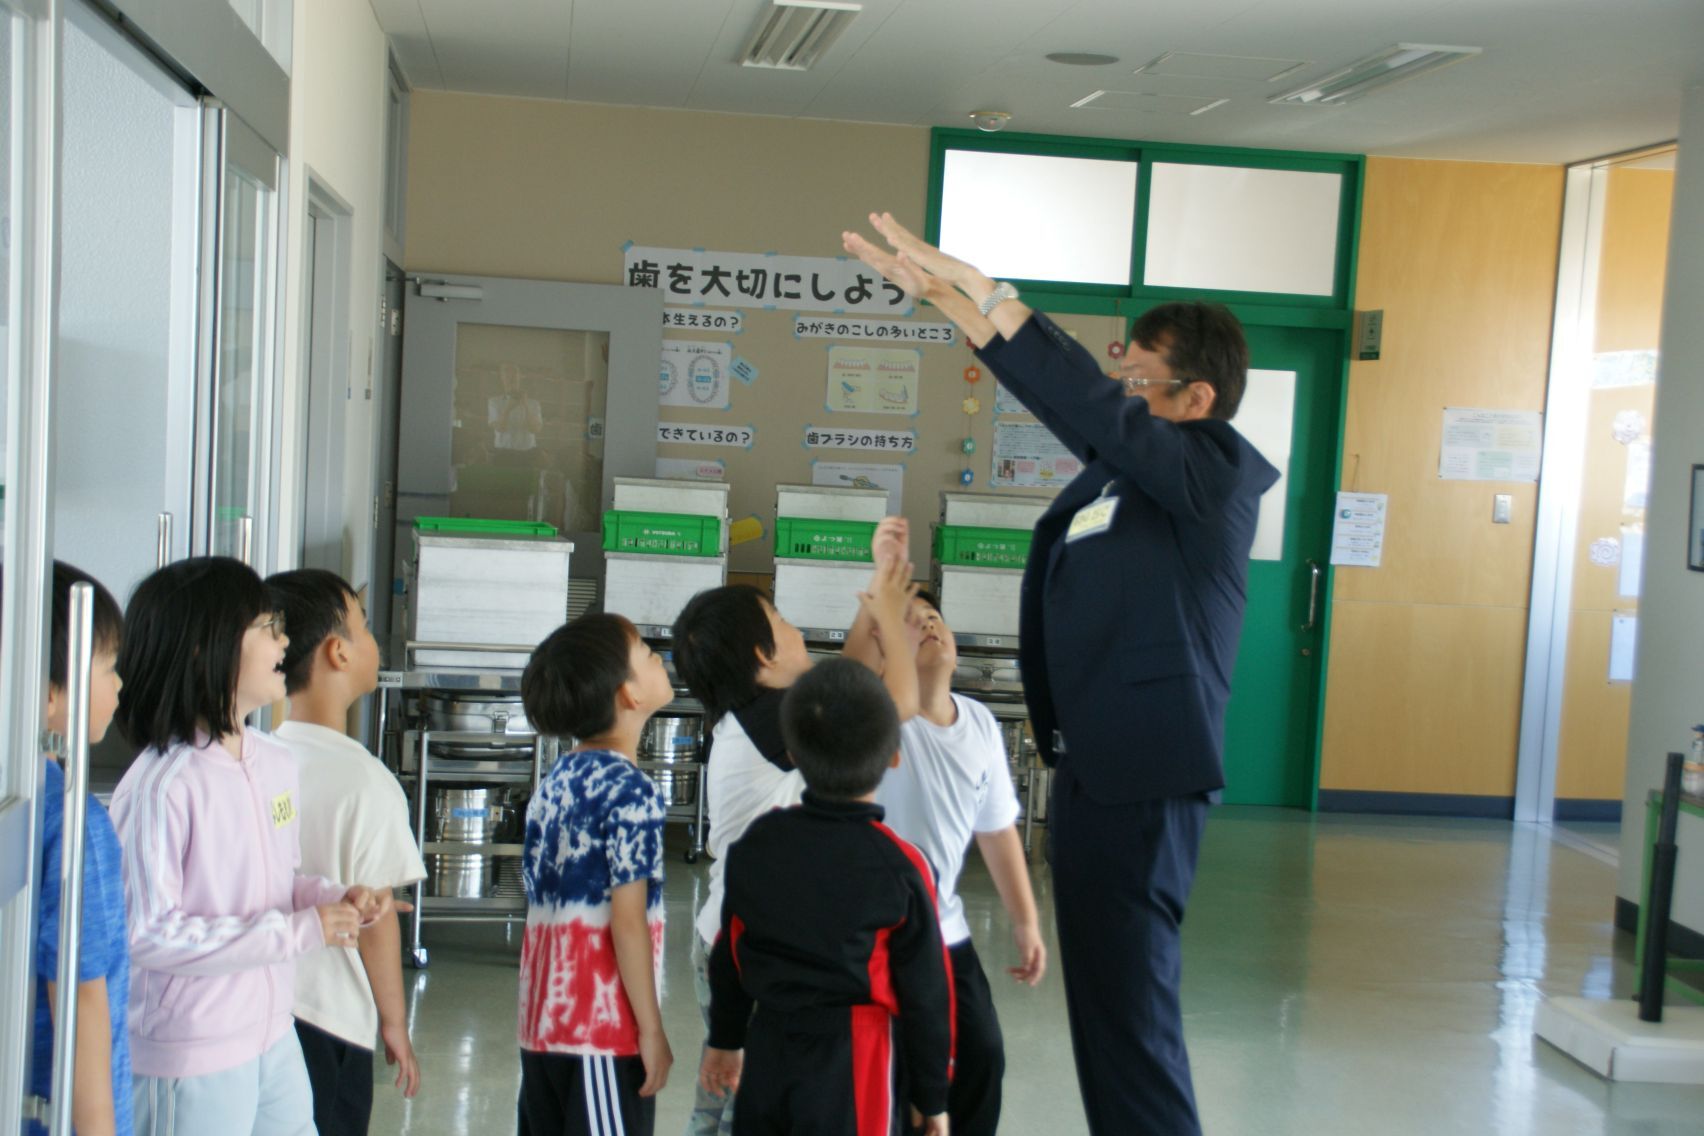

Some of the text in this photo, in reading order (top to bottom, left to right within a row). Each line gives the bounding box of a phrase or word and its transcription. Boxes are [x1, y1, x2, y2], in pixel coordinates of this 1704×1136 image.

[629, 259, 905, 306] 歯を大切にしよう
[796, 321, 953, 341] みがきのこしの多いところ
[659, 427, 750, 444] できているの？
[806, 431, 913, 449] 歯ブラシの持ち方
